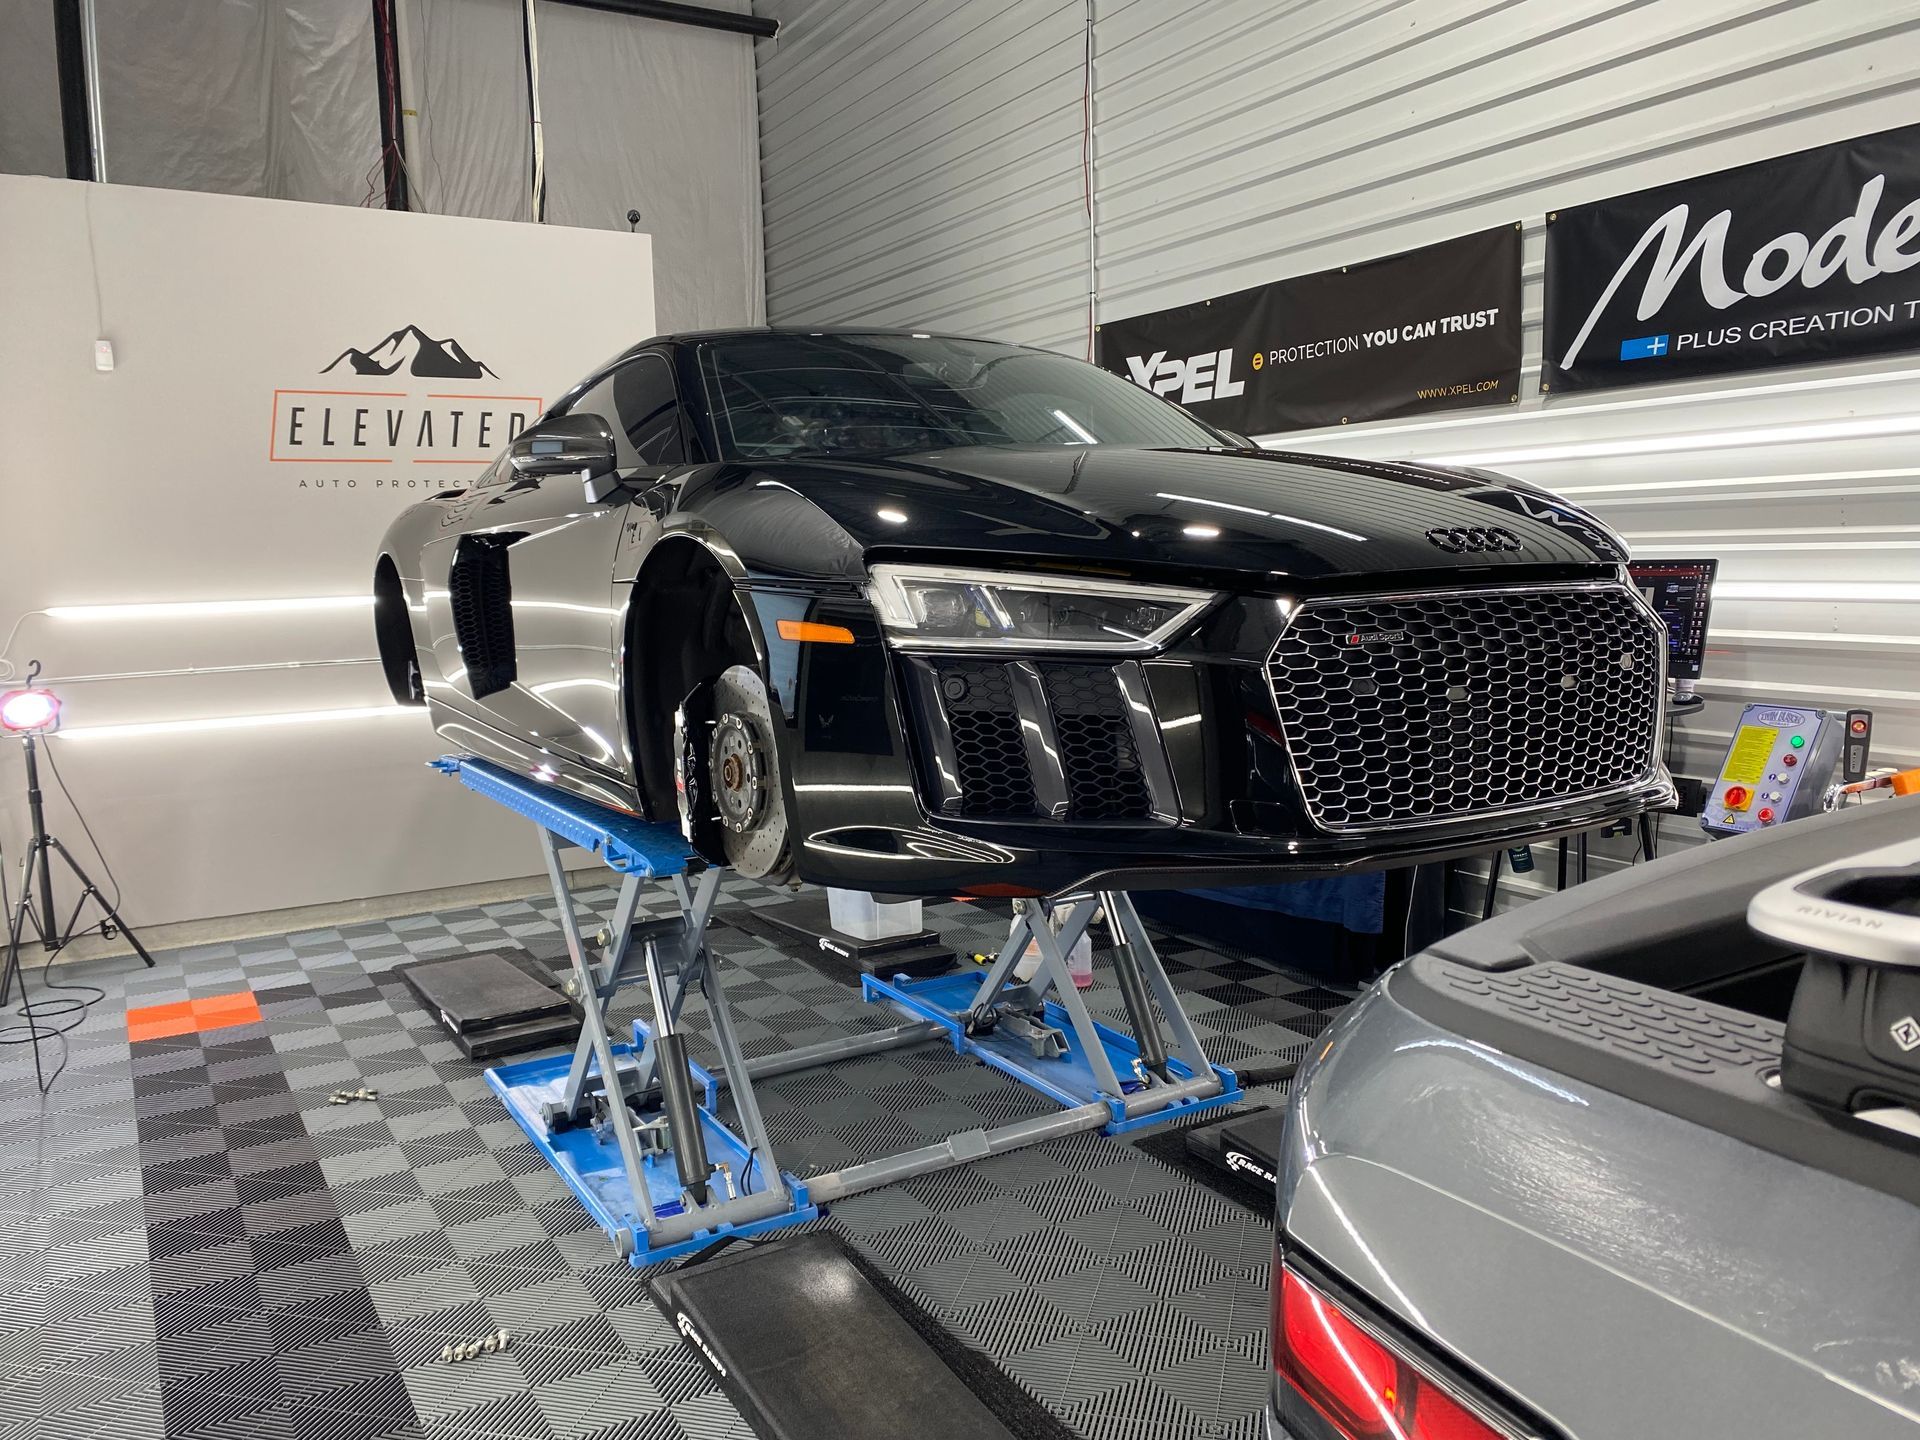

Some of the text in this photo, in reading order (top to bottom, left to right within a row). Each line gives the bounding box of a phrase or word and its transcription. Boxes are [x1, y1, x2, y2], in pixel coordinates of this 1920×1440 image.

[1269, 308, 1499, 365] PROTECTION YOU CAN TRUST
[1677, 327, 1742, 350] PLUS
[1749, 304, 1895, 340] CREATION
[1125, 348, 1245, 404] XPEL
[1417, 380, 1499, 399] WWW.XPEL.COM
[289, 407, 525, 448] ELEVATED
[299, 479, 357, 488] AUTO
[1796, 905, 1883, 929] RIVIAN
[1238, 1159, 1264, 1176] RACE
